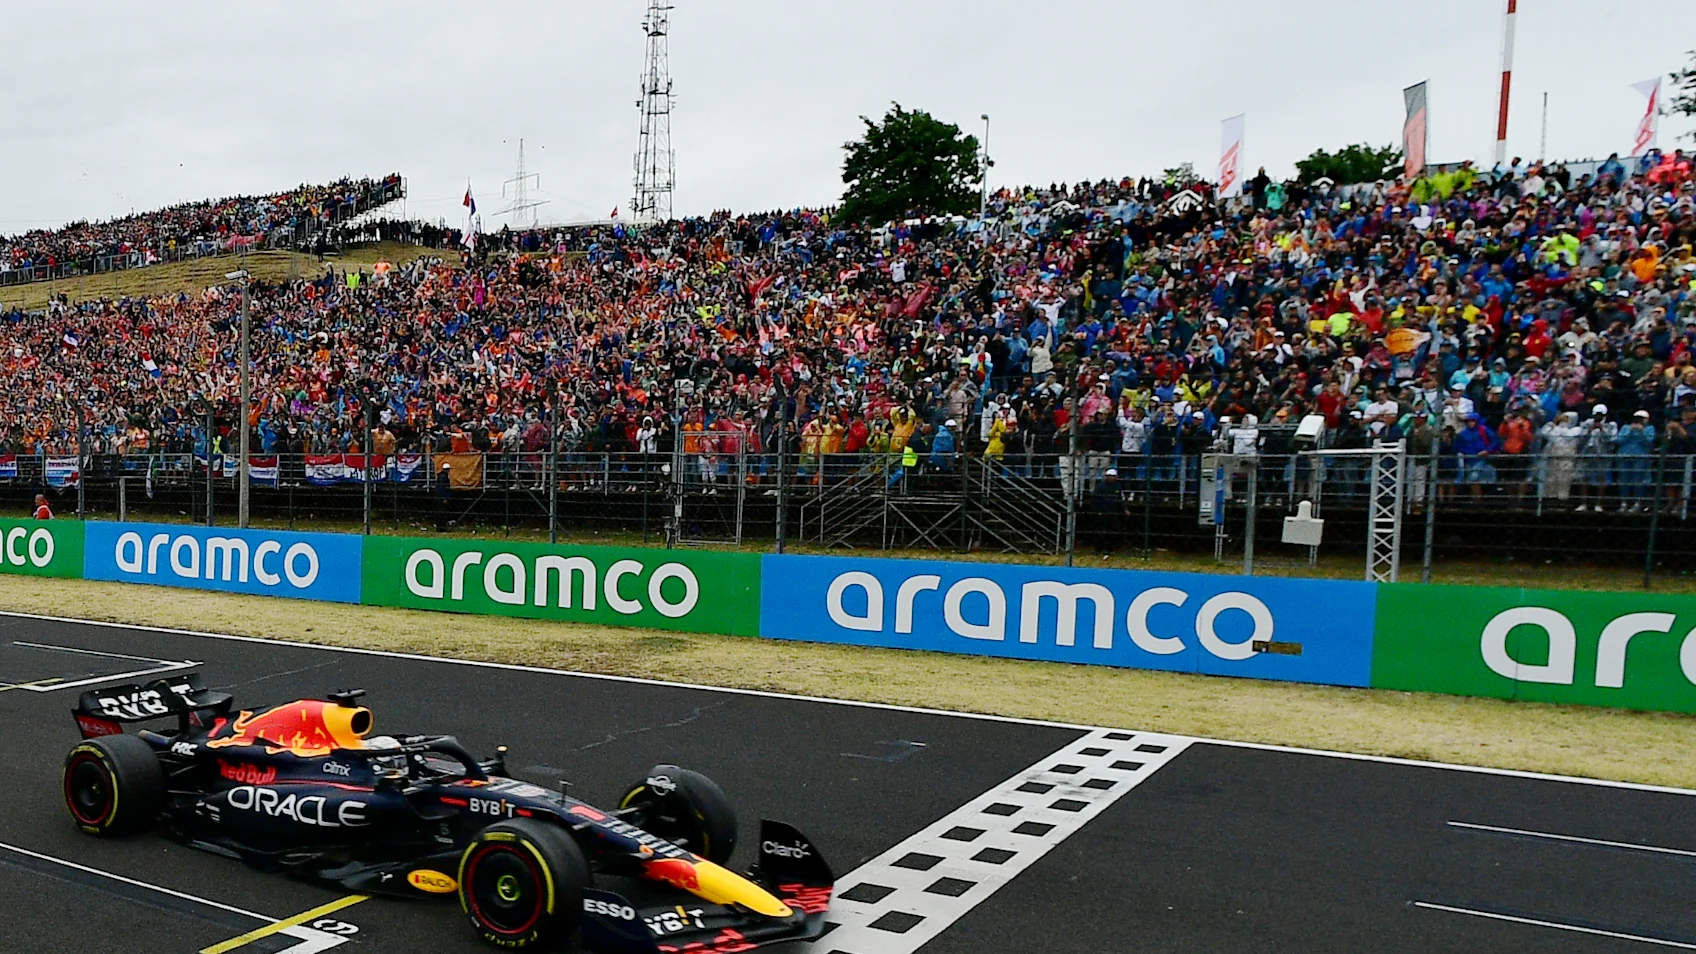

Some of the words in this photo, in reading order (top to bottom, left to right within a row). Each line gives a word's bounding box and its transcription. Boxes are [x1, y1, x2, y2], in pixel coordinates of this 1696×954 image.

[115, 532, 319, 588] aramco
[405, 549, 699, 618] aramco
[826, 571, 1277, 664] aramco
[1481, 607, 1696, 689] ar
[171, 742, 199, 756] HRC
[227, 784, 368, 827] ORACLE
[470, 798, 515, 818] BYBIT
[584, 898, 636, 921] ESSO
